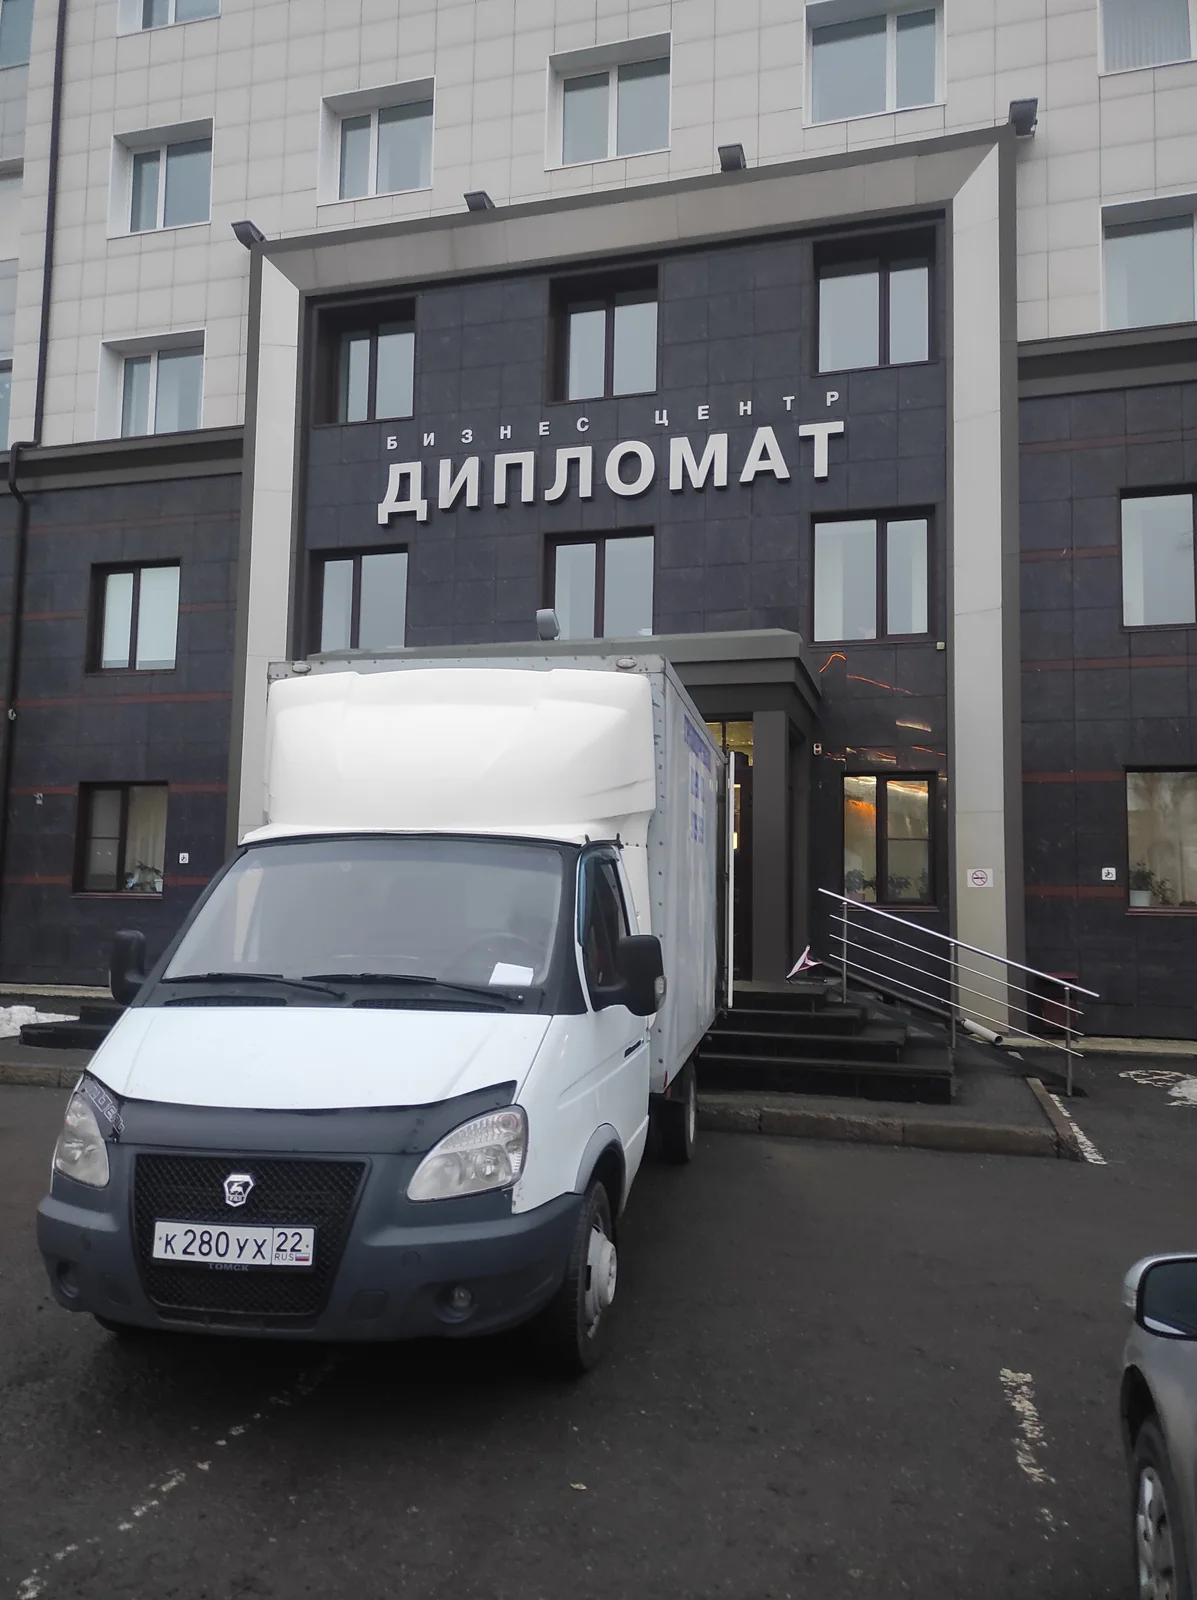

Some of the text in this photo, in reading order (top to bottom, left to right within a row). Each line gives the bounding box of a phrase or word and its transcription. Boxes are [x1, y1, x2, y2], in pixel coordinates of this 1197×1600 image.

[386, 390, 839, 449] БИЗНЕС ЦЕНТР
[377, 420, 845, 525] ДИПЛОМАТ
[164, 1229, 303, 1260] К280УХ 22
[274, 1252, 295, 1262] RUS
[207, 1262, 250, 1272] ТОМСК
